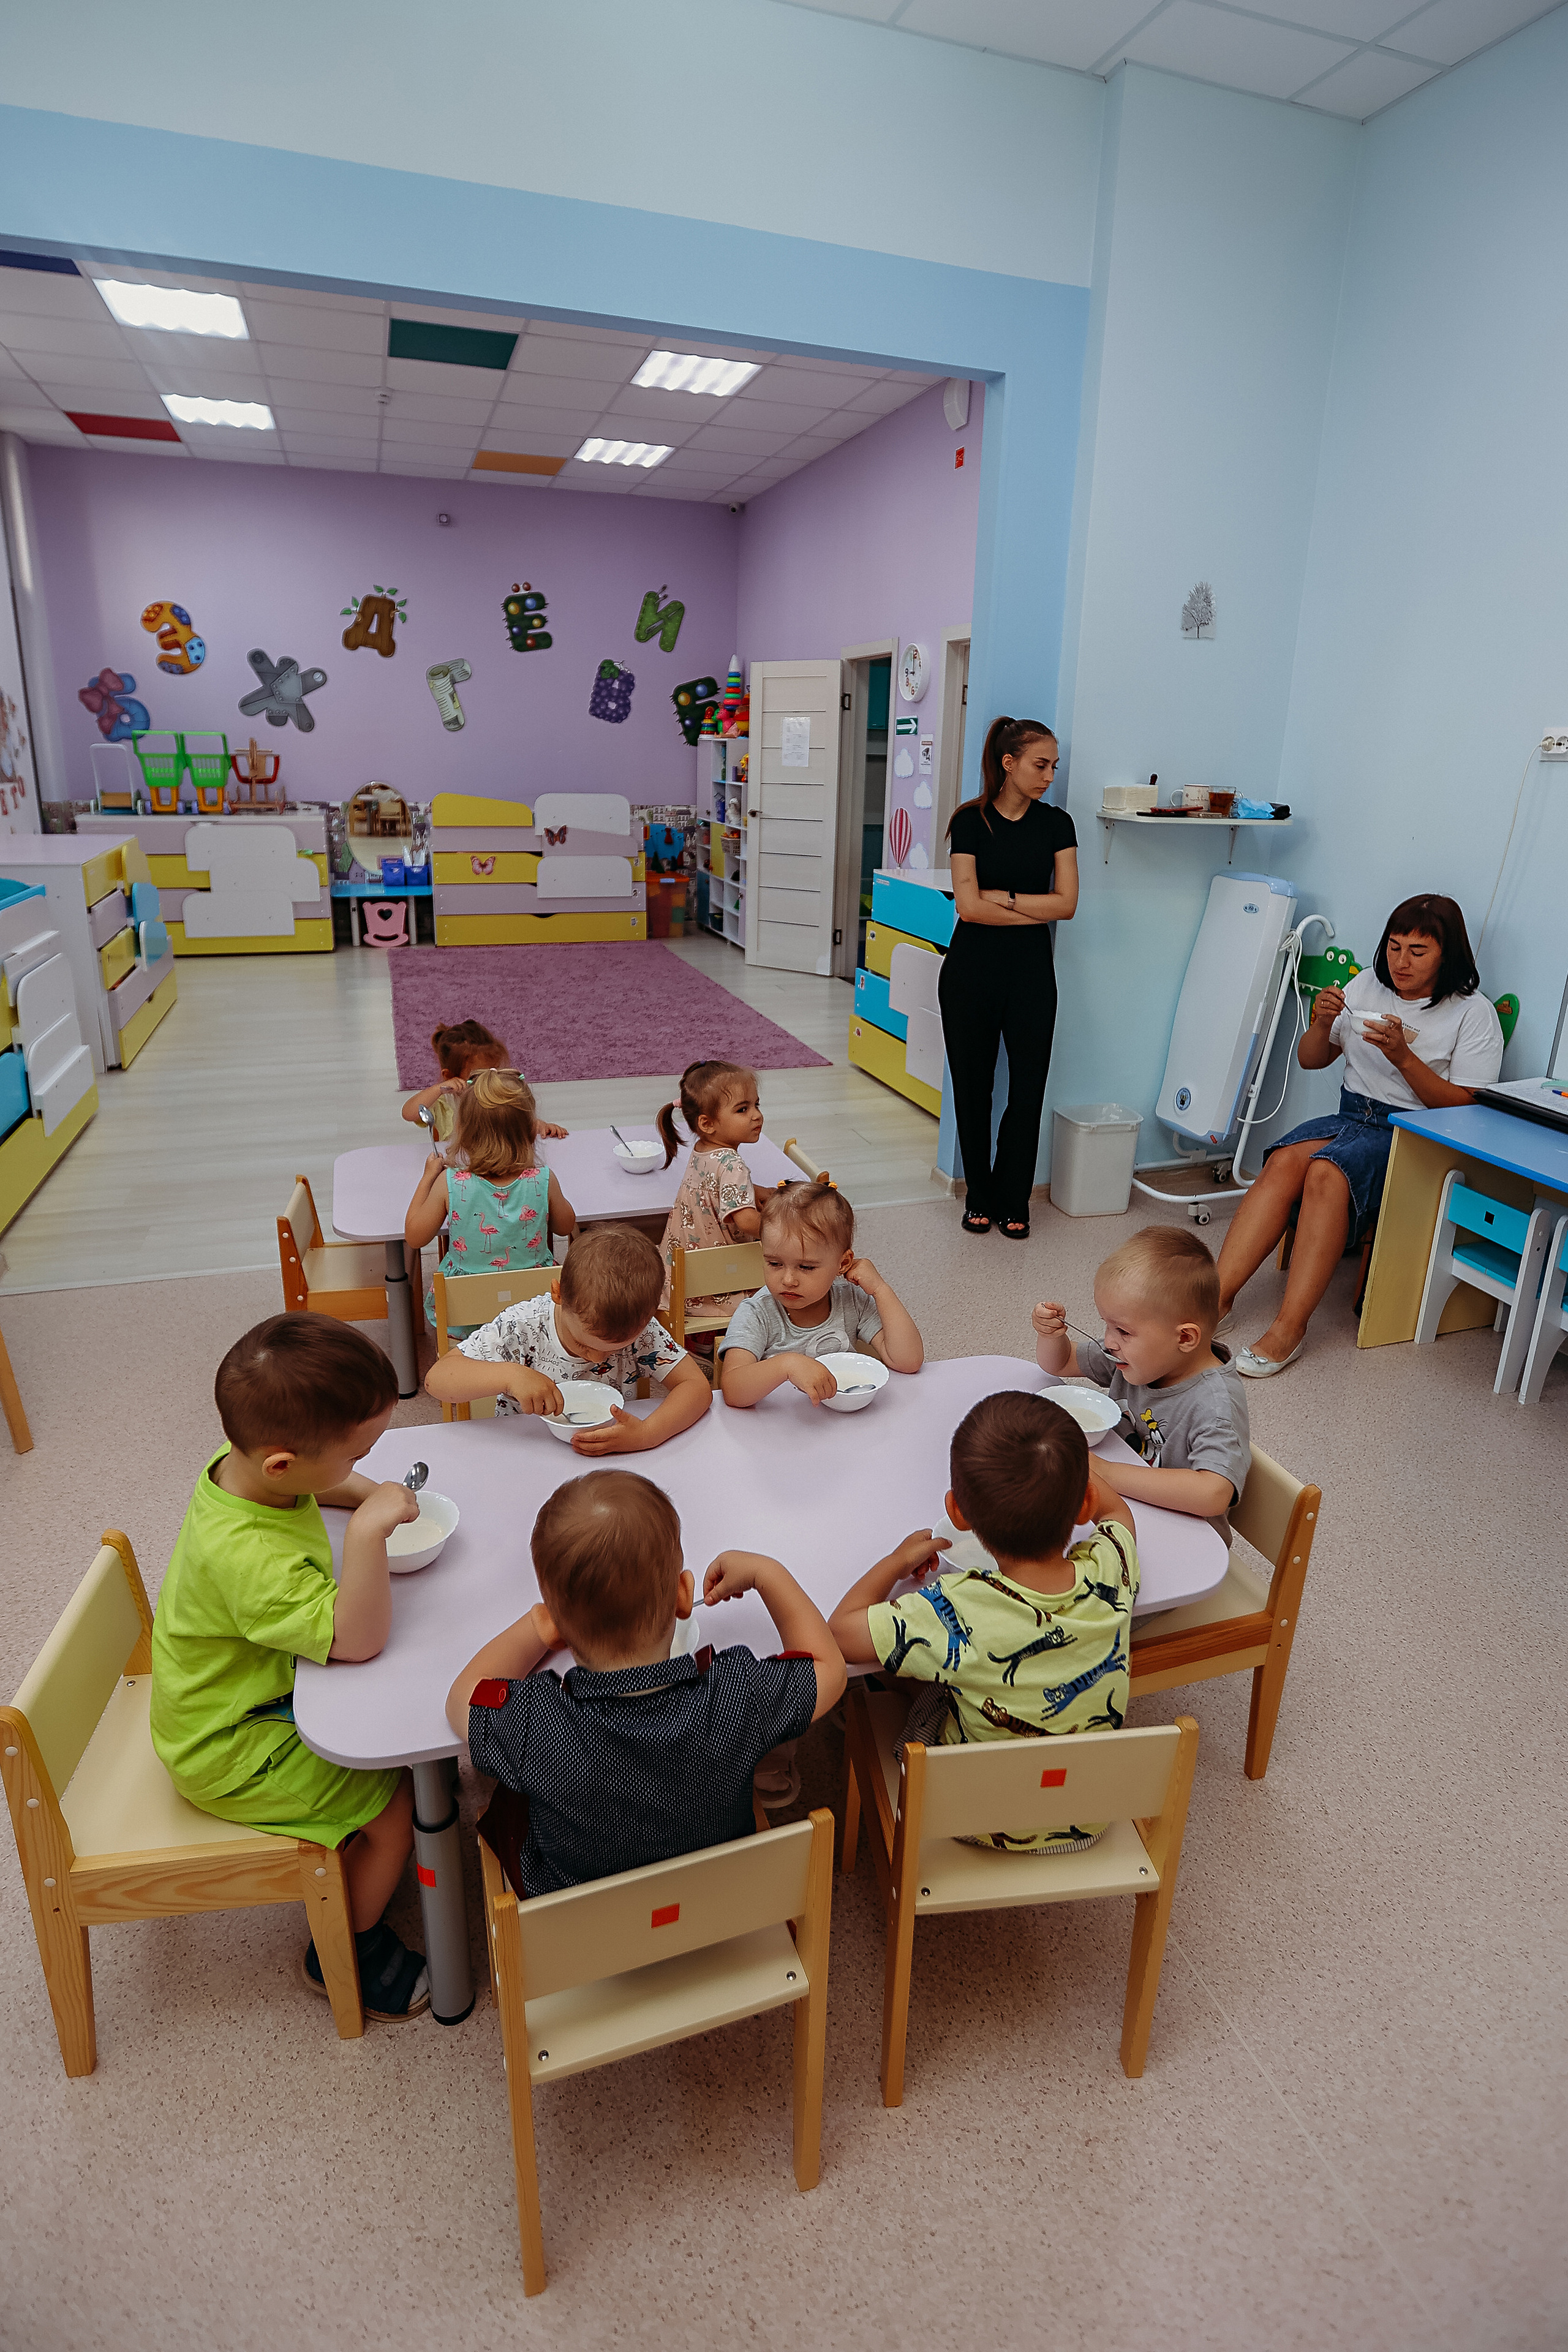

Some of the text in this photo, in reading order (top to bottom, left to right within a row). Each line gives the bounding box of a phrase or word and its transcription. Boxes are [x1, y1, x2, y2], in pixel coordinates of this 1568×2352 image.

[341, 594, 396, 658] Д
[634, 590, 685, 652] И
[238, 647, 327, 730] Ж
[588, 659, 635, 724] В
[524, 1319, 540, 1343] planet
[539, 1356, 560, 1366] cosmos
